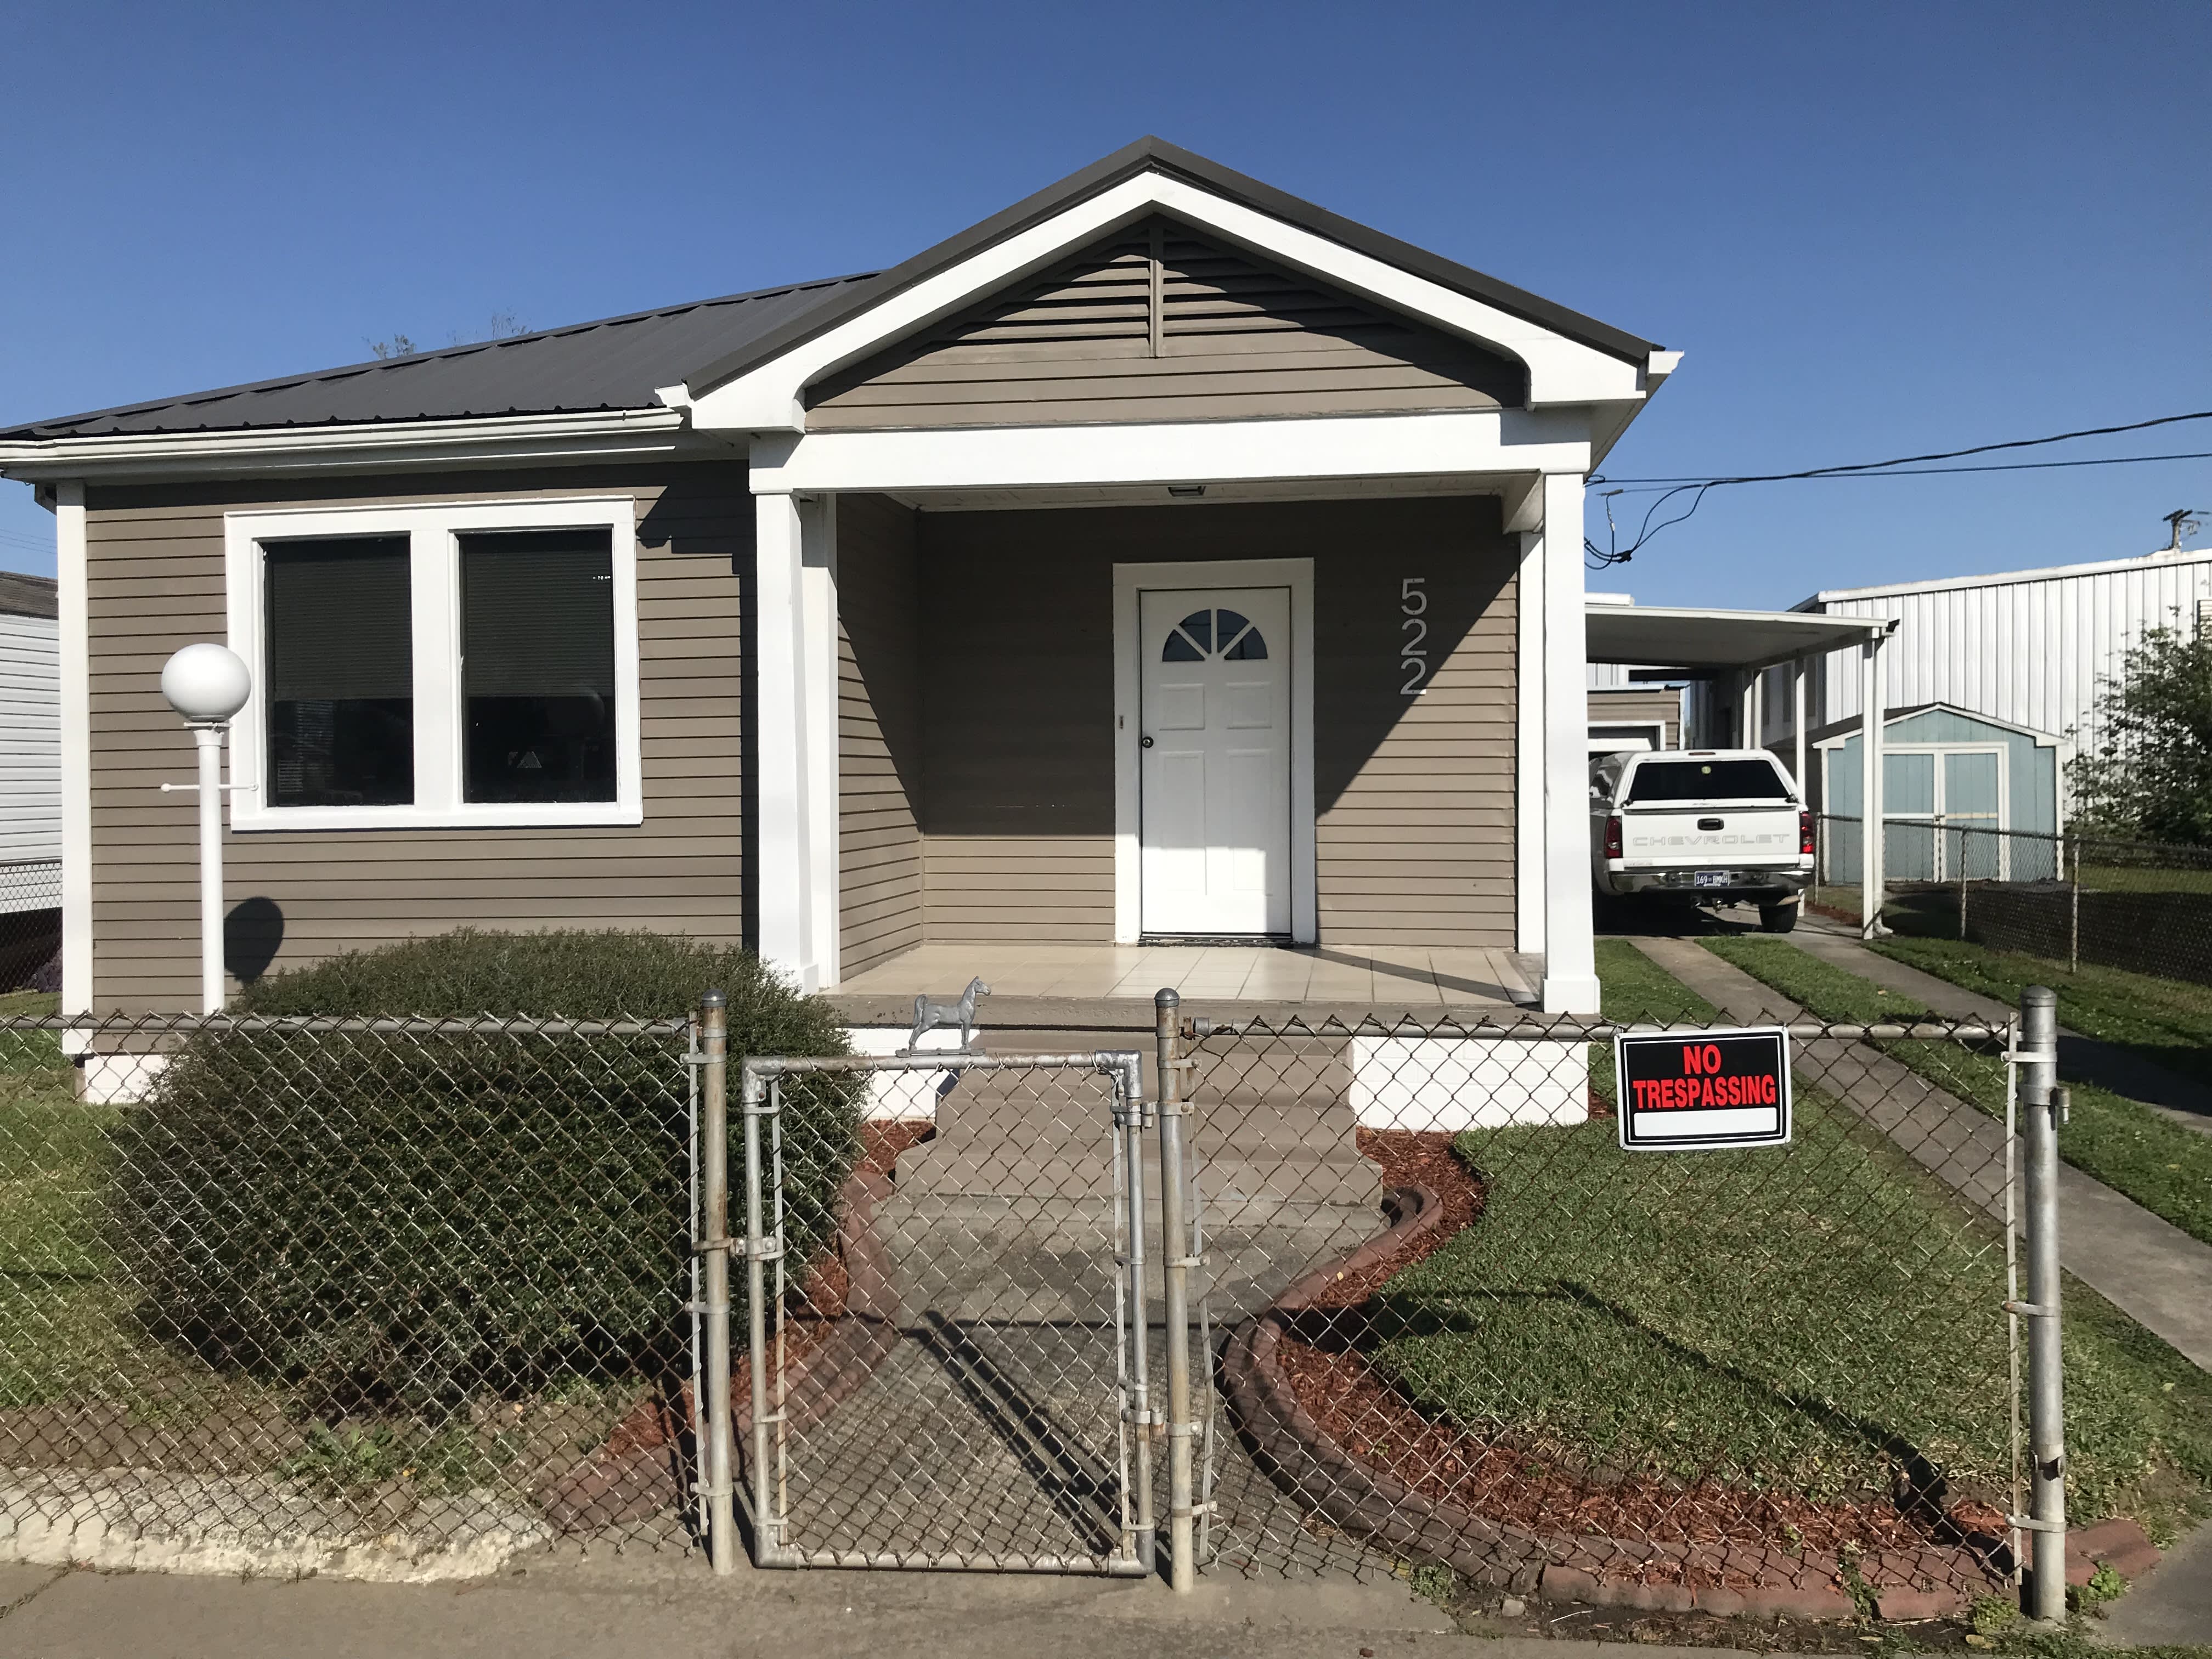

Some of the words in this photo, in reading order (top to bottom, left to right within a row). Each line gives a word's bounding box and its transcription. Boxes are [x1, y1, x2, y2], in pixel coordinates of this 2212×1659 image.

[1401, 578, 1426, 695] 522
[1632, 834, 1790, 847] CHEVROLET
[1683, 1044, 1722, 1074] NO
[1633, 1075, 1776, 1109] TRESPASSING
